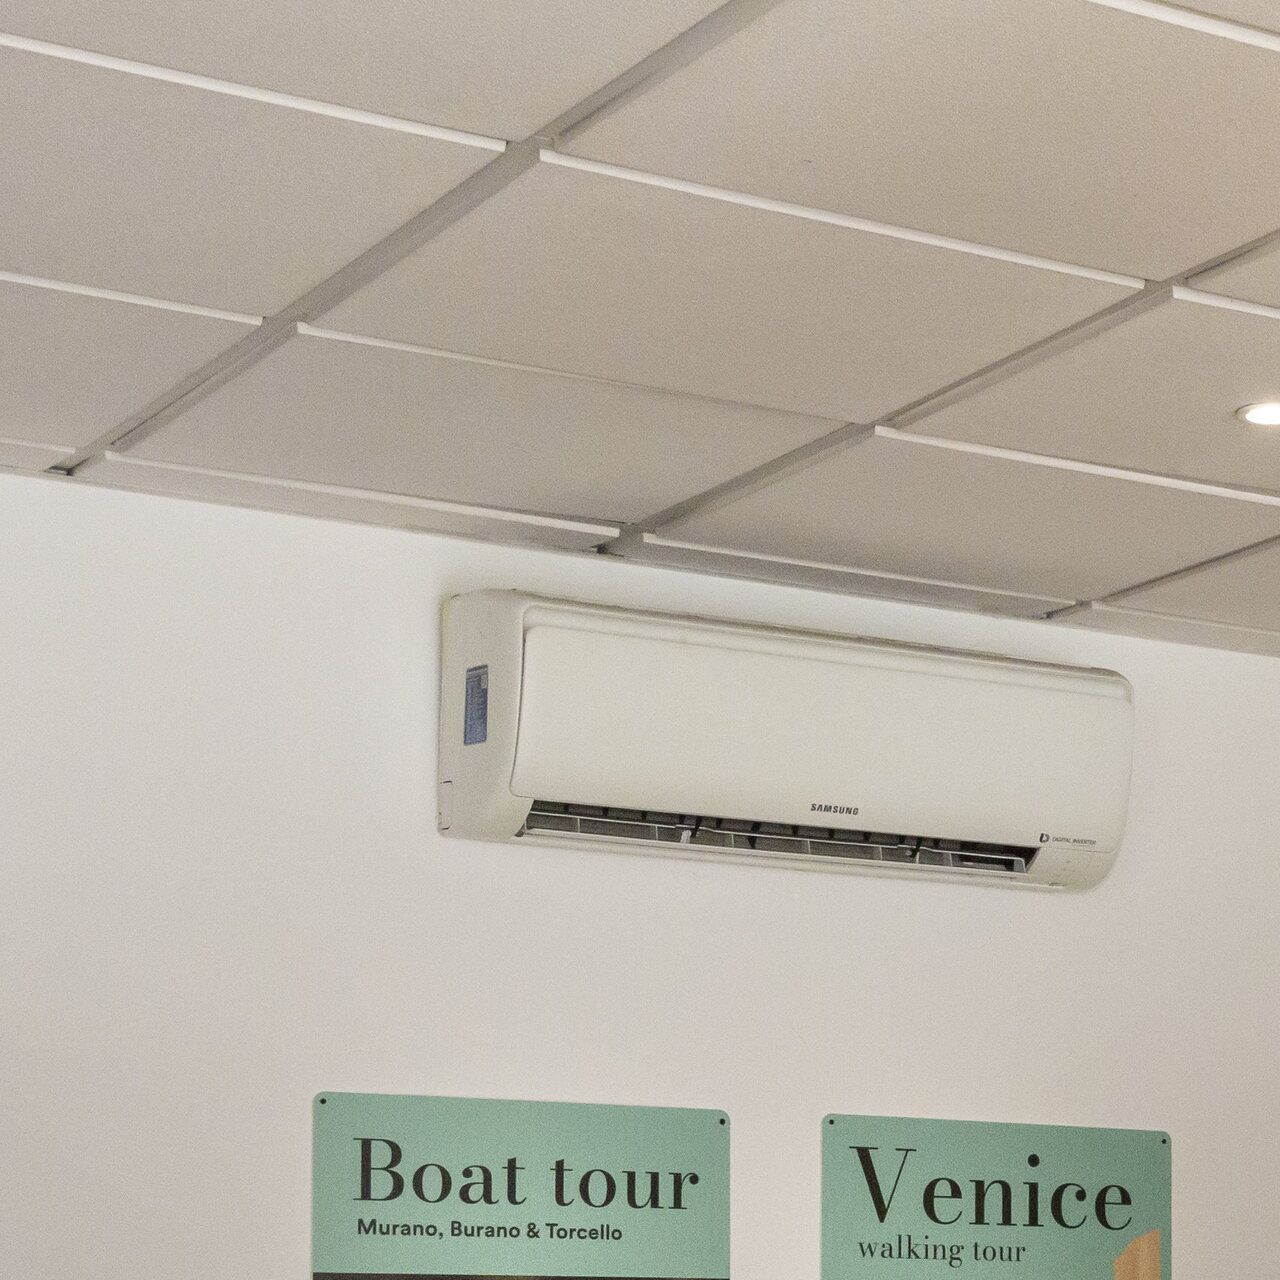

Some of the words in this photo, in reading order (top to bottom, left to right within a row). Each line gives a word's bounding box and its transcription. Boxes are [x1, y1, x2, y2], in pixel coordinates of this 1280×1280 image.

[811, 803, 859, 815] SAMSUNG
[353, 1137, 527, 1206] Boat
[551, 1158, 699, 1209] tour
[849, 1146, 1132, 1230] Venice
[357, 1218, 443, 1239] Murano,
[451, 1221, 520, 1239] Burano
[527, 1223, 540, 1238] &
[546, 1223, 622, 1241] Torcello
[858, 1235, 964, 1268] walking
[972, 1241, 1026, 1262] tour
